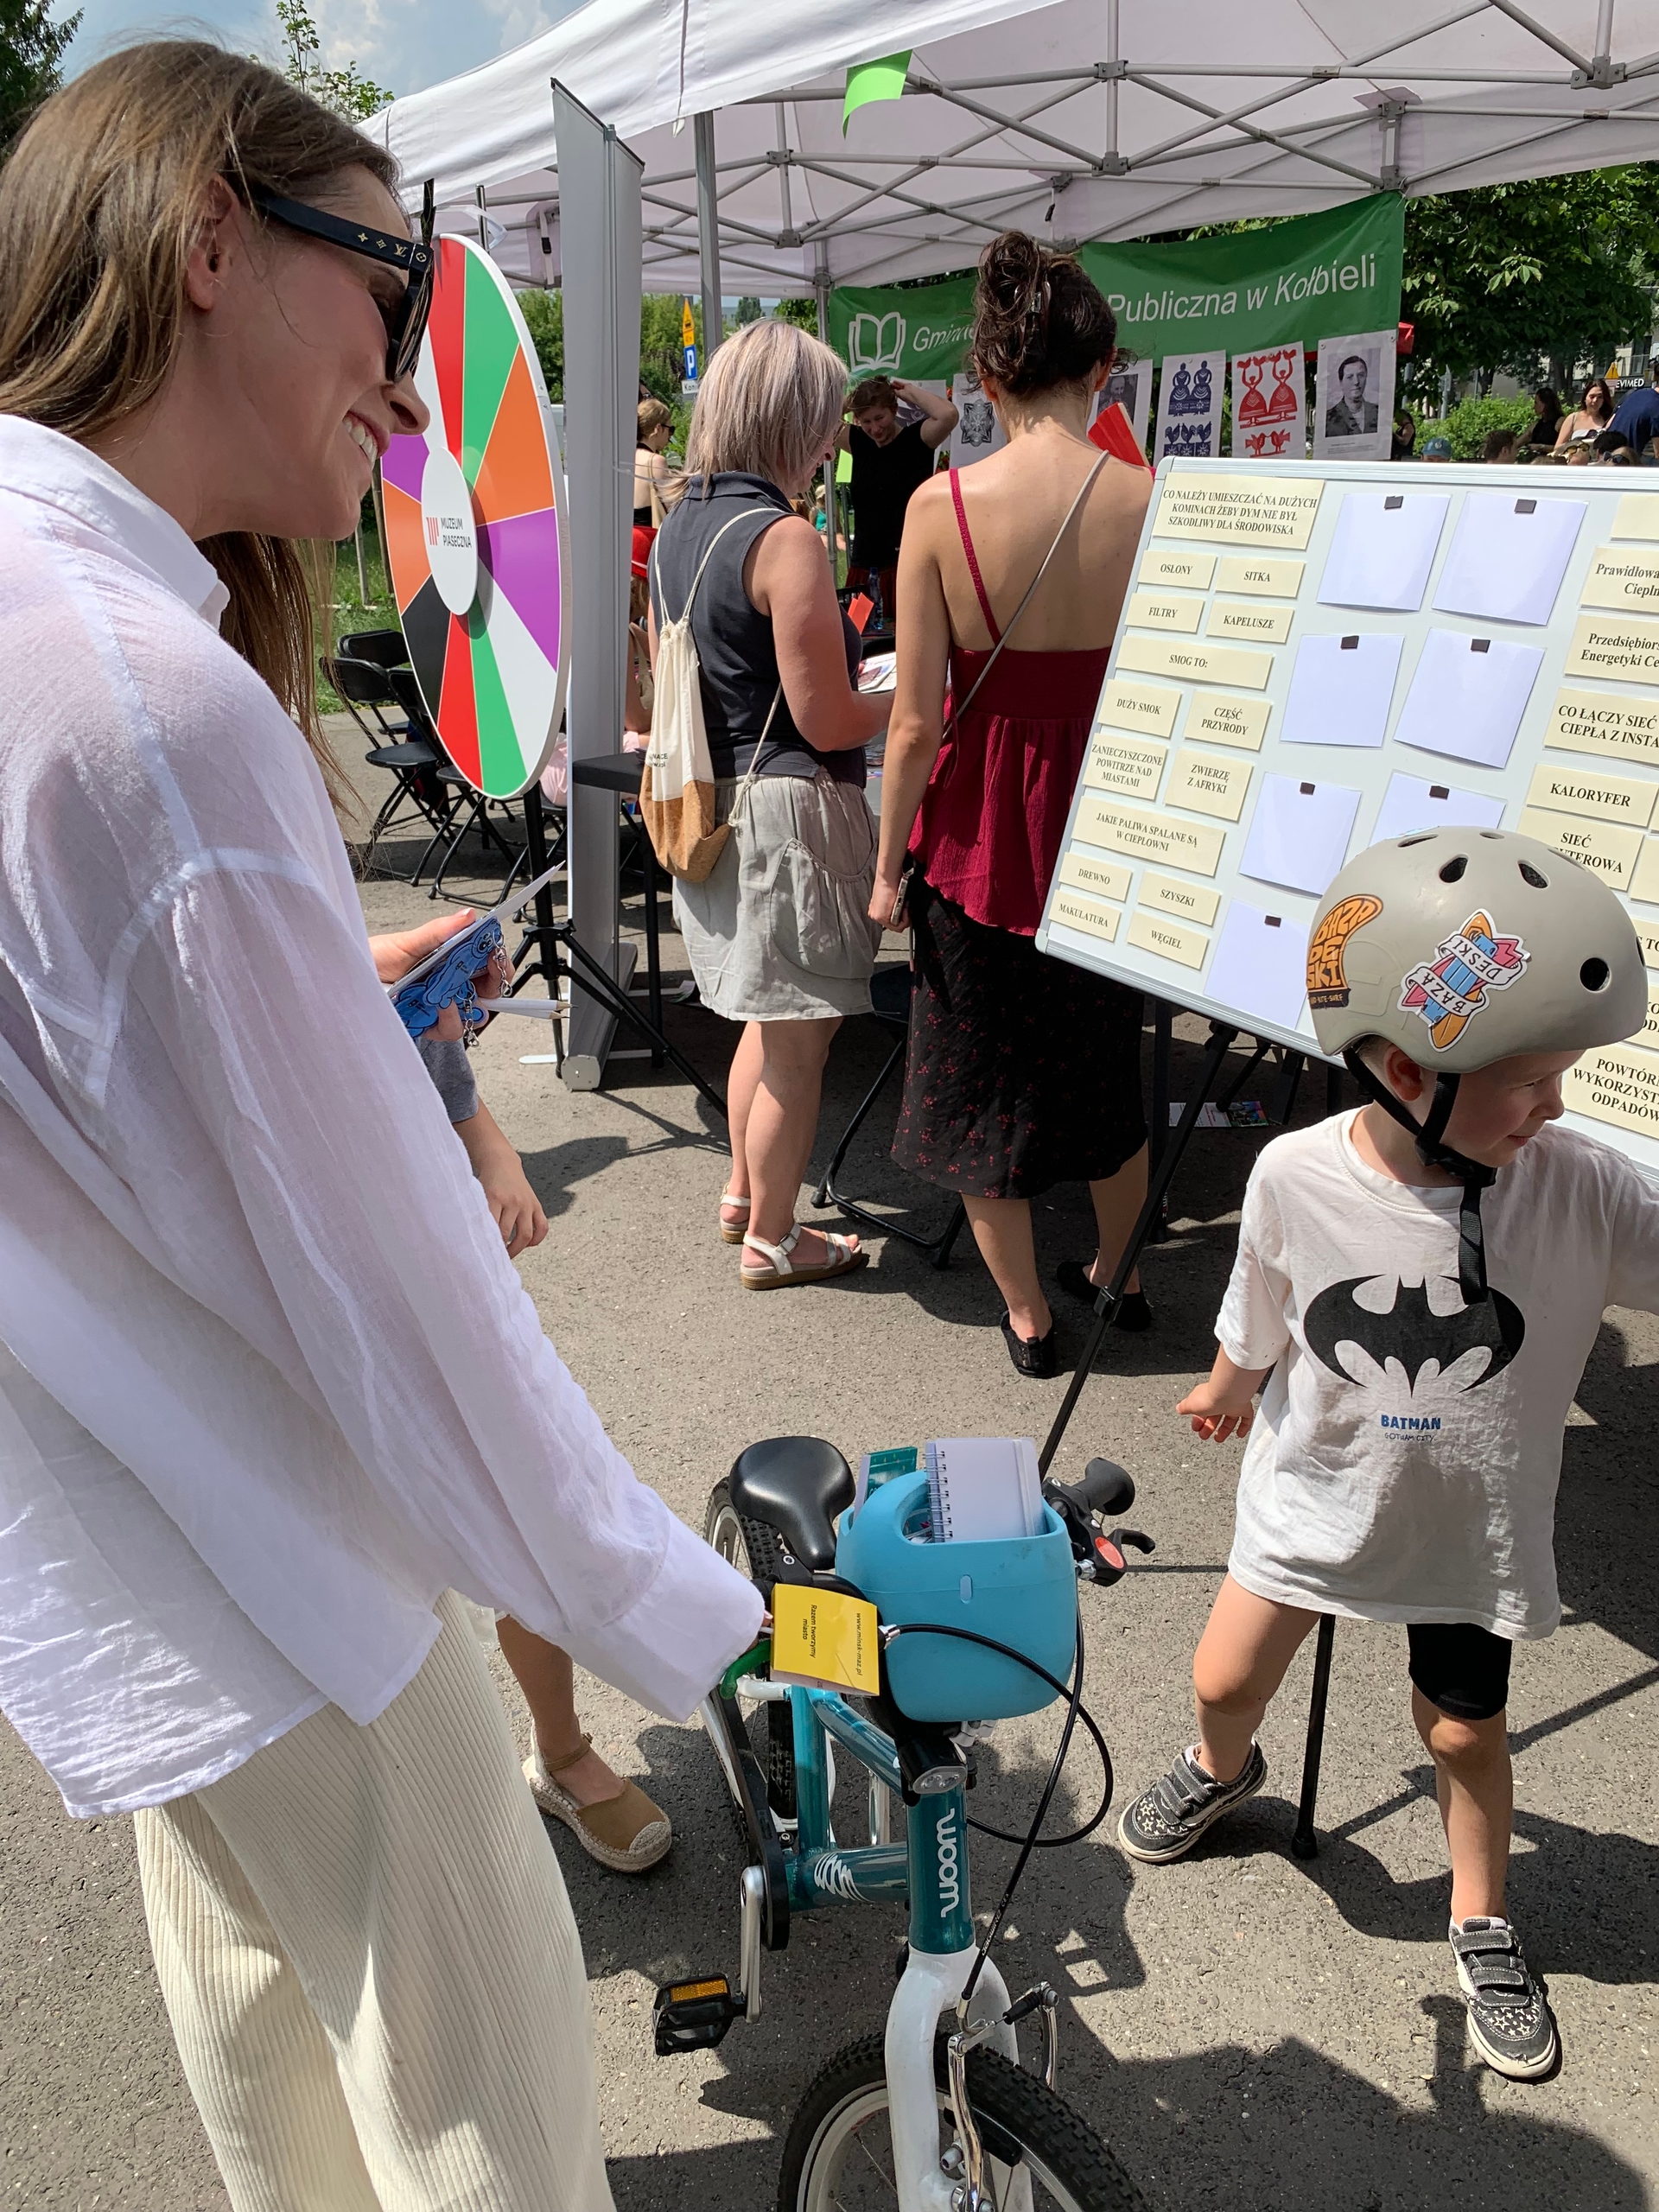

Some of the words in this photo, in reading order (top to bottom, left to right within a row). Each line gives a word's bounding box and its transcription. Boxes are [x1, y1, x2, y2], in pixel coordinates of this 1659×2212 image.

[1107, 290, 1237, 322] Publiczna
[1247, 286, 1268, 310] w
[1274, 253, 1376, 306] Kołbieli
[1163, 490, 1175, 499] CO
[1176, 490, 1209, 501] NALEŻY
[1209, 492, 1263, 505] UMIESZCZAĆ
[1263, 496, 1277, 505] NA
[1279, 496, 1318, 508] DUŻYCH
[1172, 504, 1217, 515] KOMINACH
[1217, 505, 1240, 518] ŻEBY
[1239, 508, 1262, 518] DYM
[1262, 510, 1279, 520] NIE
[1280, 511, 1298, 521] BYŁ
[441, 518, 463, 530] MUZEUM
[1168, 517, 1216, 528] SZKODLIWY
[1217, 519, 1233, 530] DLA
[1235, 519, 1294, 535] ŚRODOWISKA
[442, 534, 472, 548] PIASECZNA
[1160, 563, 1193, 575] OSŁONY
[1243, 571, 1270, 582] SITKA
[1595, 563, 1659, 579] Prawidłowa
[1148, 607, 1178, 618] FILTRY
[1223, 615, 1274, 629] KAPELUSZE
[1169, 654, 1192, 666] SMOG
[1193, 658, 1208, 668] TO:
[1580, 649, 1642, 666] Energetyki
[1116, 698, 1138, 710] DUŻY
[1138, 702, 1162, 715] SMOK
[1214, 707, 1243, 721] CZĘŚĆ
[1559, 704, 1577, 717] CO
[1580, 707, 1624, 726] ŁĄCZY
[1625, 715, 1657, 729] SIEĆ
[1201, 719, 1249, 735] PRZYRODY
[1560, 721, 1607, 741] CIEPŁA
[1609, 730, 1618, 741] Z
[1091, 744, 1164, 766] ZANIECZYSZCZONE
[1096, 759, 1136, 773] POWITRZE
[1135, 766, 1153, 777] NAD
[1191, 765, 1230, 783] ZWIERZĘ
[1102, 772, 1141, 787] MIASTAMI
[1187, 777, 1193, 786] Z
[1193, 779, 1228, 794] AFRYKI
[1550, 783, 1630, 807] KALORYFER
[1096, 812, 1118, 825] JAKIE
[1118, 820, 1147, 833] PALIWA
[1148, 826, 1186, 842] SPALANE
[1186, 836, 1198, 848] SĄ
[1116, 830, 1124, 839] W
[1124, 833, 1169, 852] CIEPŁOWNI
[1560, 832, 1592, 849] SIEĆ
[1077, 868, 1110, 885] DREWNO
[1160, 889, 1195, 907] SZYSZKI
[1058, 903, 1109, 927] MAKULATURA
[1313, 899, 1376, 946] BAZA
[1151, 930, 1182, 950] WĘGIEL
[1308, 935, 1344, 964] DE
[1452, 939, 1503, 981] DESKI
[1423, 972, 1466, 1014] BAZA
[1381, 1414, 1441, 1430] BATMAN
[1384, 1433, 1414, 1441] GOTHAM
[936, 1808, 959, 1918] woom
